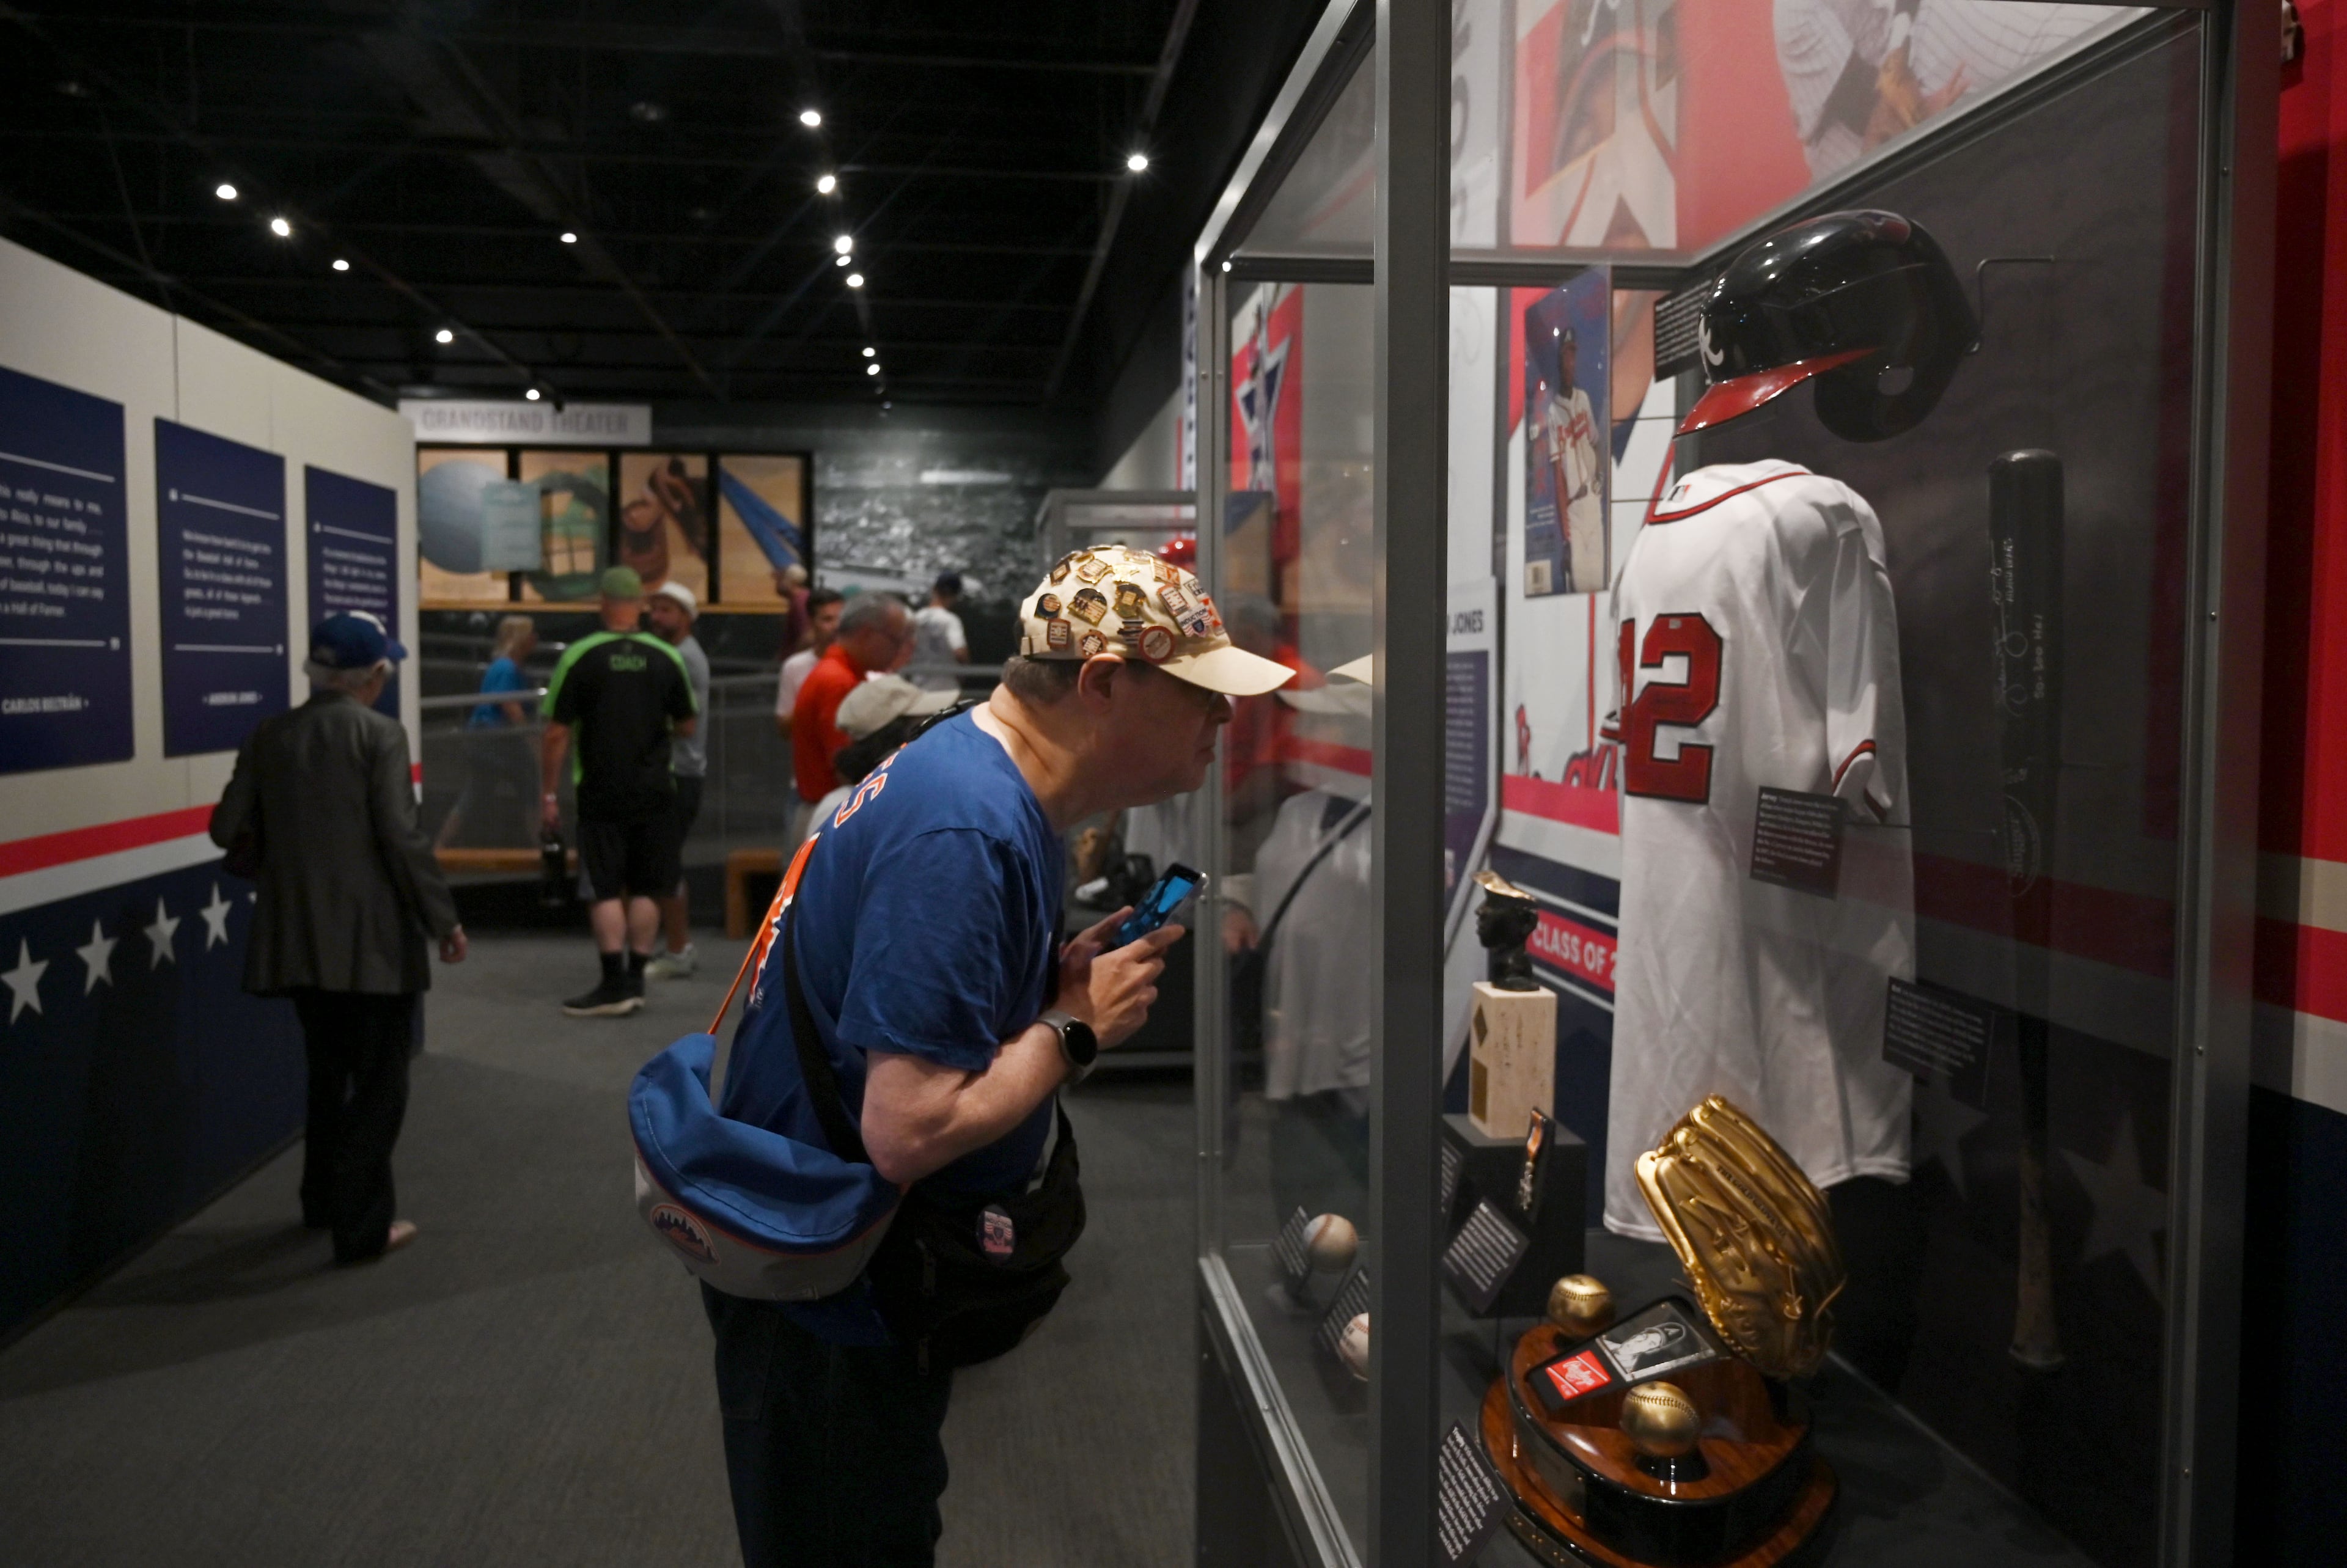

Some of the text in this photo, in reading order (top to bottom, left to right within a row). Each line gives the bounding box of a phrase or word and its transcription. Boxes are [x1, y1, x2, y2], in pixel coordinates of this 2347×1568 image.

[422, 408, 629, 432] GRANDSTAND THEATER
[1181, 607, 1208, 626] INDUCTION
[1453, 609, 1483, 636] JONES
[610, 653, 647, 671] COACH
[2, 692, 82, 714] CARLOS BELTRÁN
[1532, 920, 1581, 965] CLASS
[1583, 941, 1607, 975] OF
